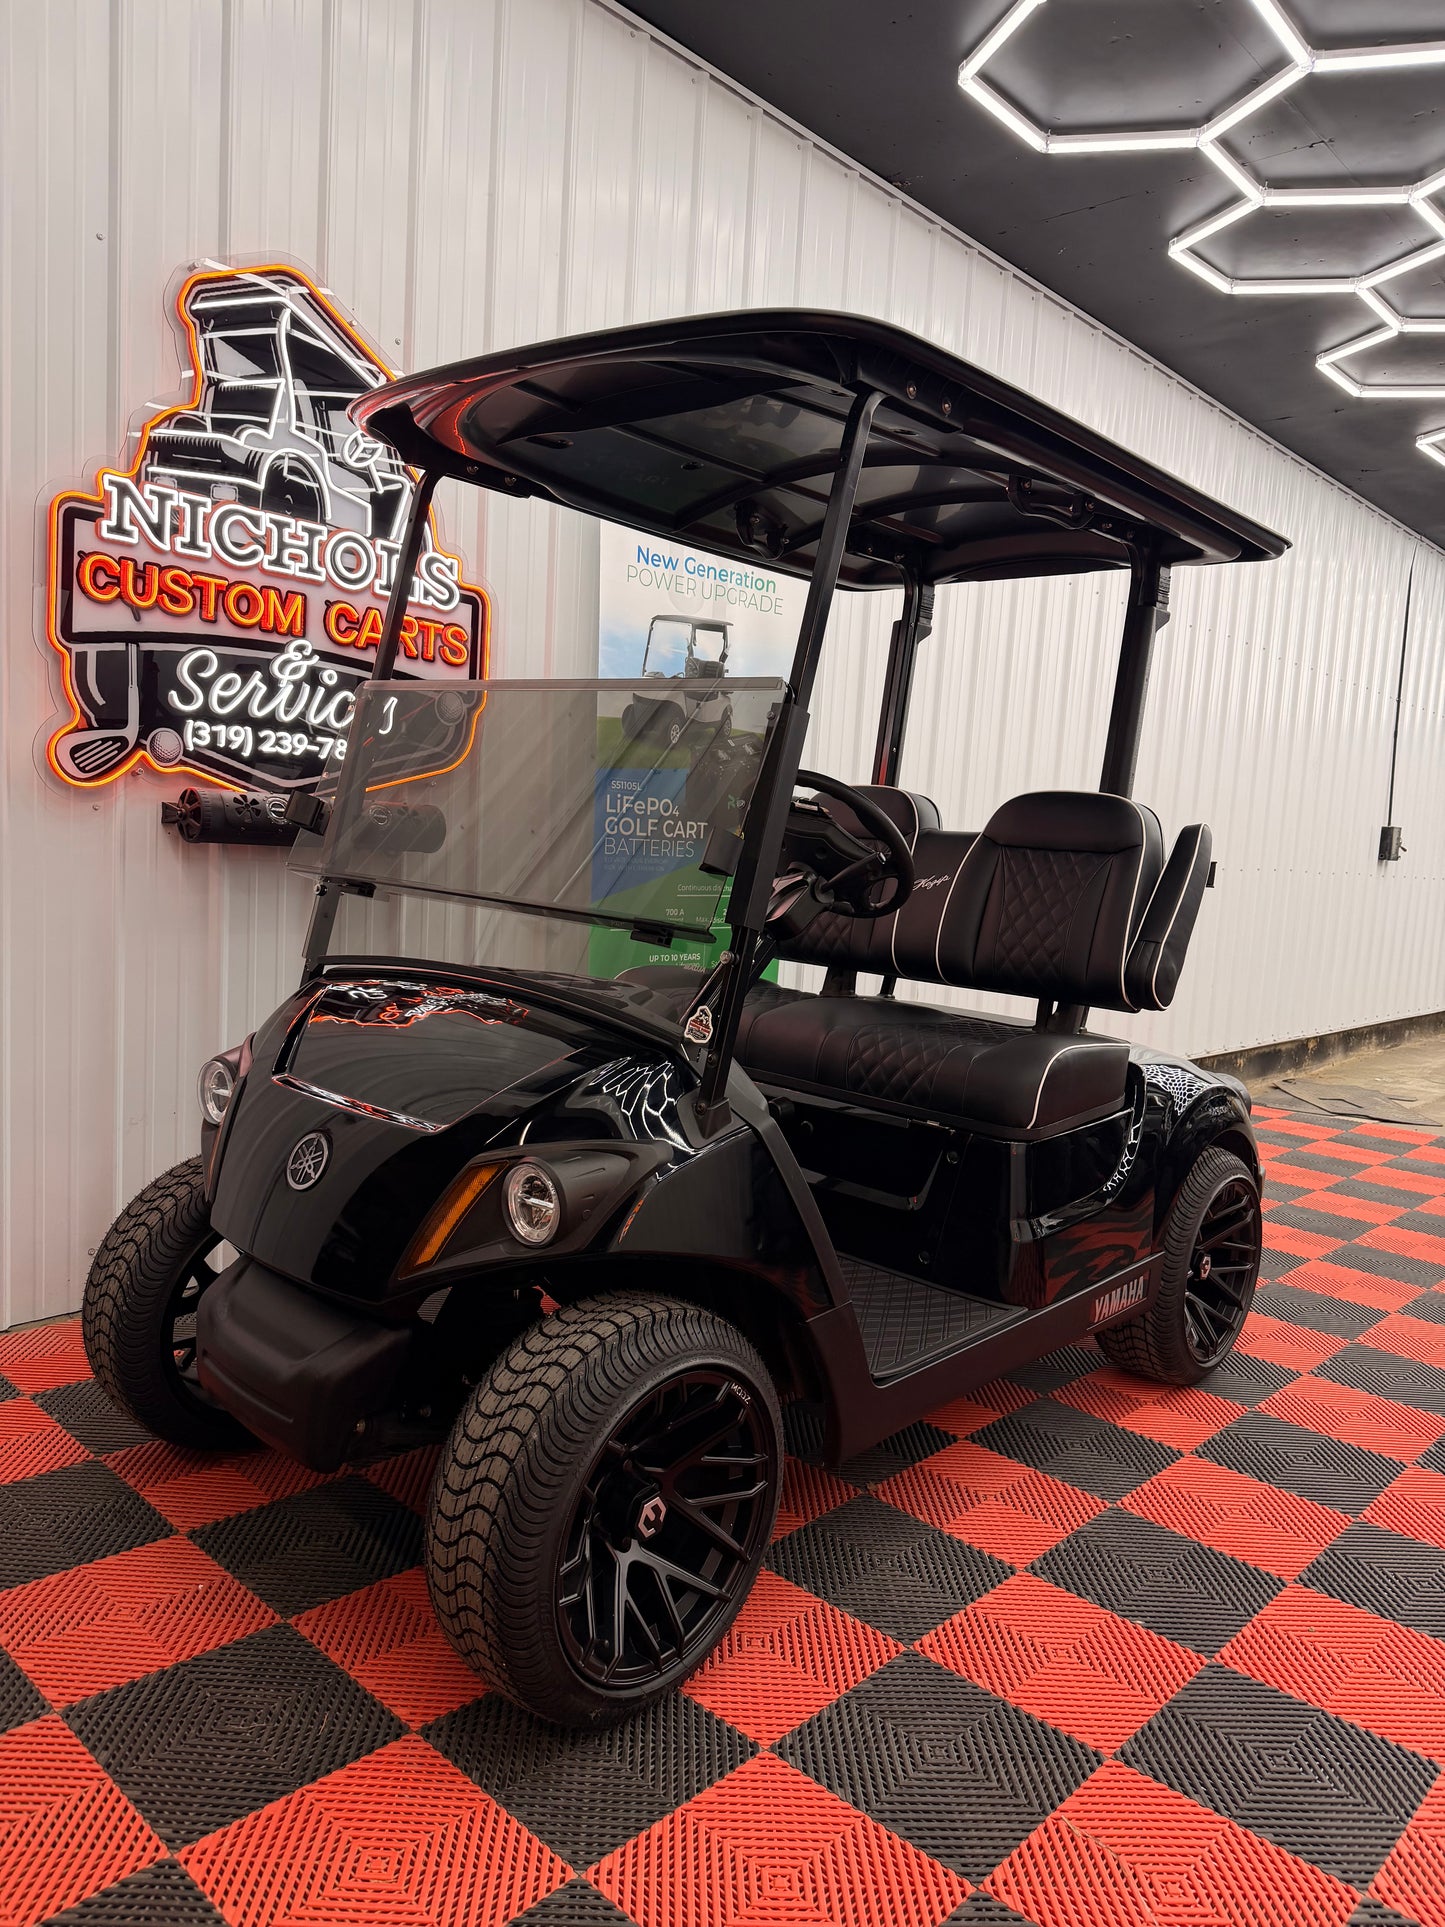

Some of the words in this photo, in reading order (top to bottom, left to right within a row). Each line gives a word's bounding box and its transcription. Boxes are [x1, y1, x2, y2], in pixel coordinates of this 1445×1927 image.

[99, 474, 461, 612] NICHOLS
[637, 545, 679, 571] New
[685, 557, 776, 593] Generation
[627, 565, 697, 597] POWER
[701, 582, 784, 615] UPGRADE
[80, 553, 307, 636] CUSTOM
[325, 599, 470, 667] CARTS
[269, 638, 320, 688] &
[183, 719, 254, 757] (319)
[611, 780, 642, 791] S51105L
[606, 794, 680, 817] LiFePO4
[605, 816, 658, 837] GOLF
[662, 820, 708, 839] CART
[604, 837, 695, 858] BATTERIES
[677, 883, 712, 892] Continuous
[666, 908, 678, 916] 700
[679, 908, 685, 916] A
[649, 955, 660, 963] UP
[671, 954, 679, 962] 10
[680, 953, 701, 961] YEARS
[1094, 1275, 1144, 1323] YAMAHA
